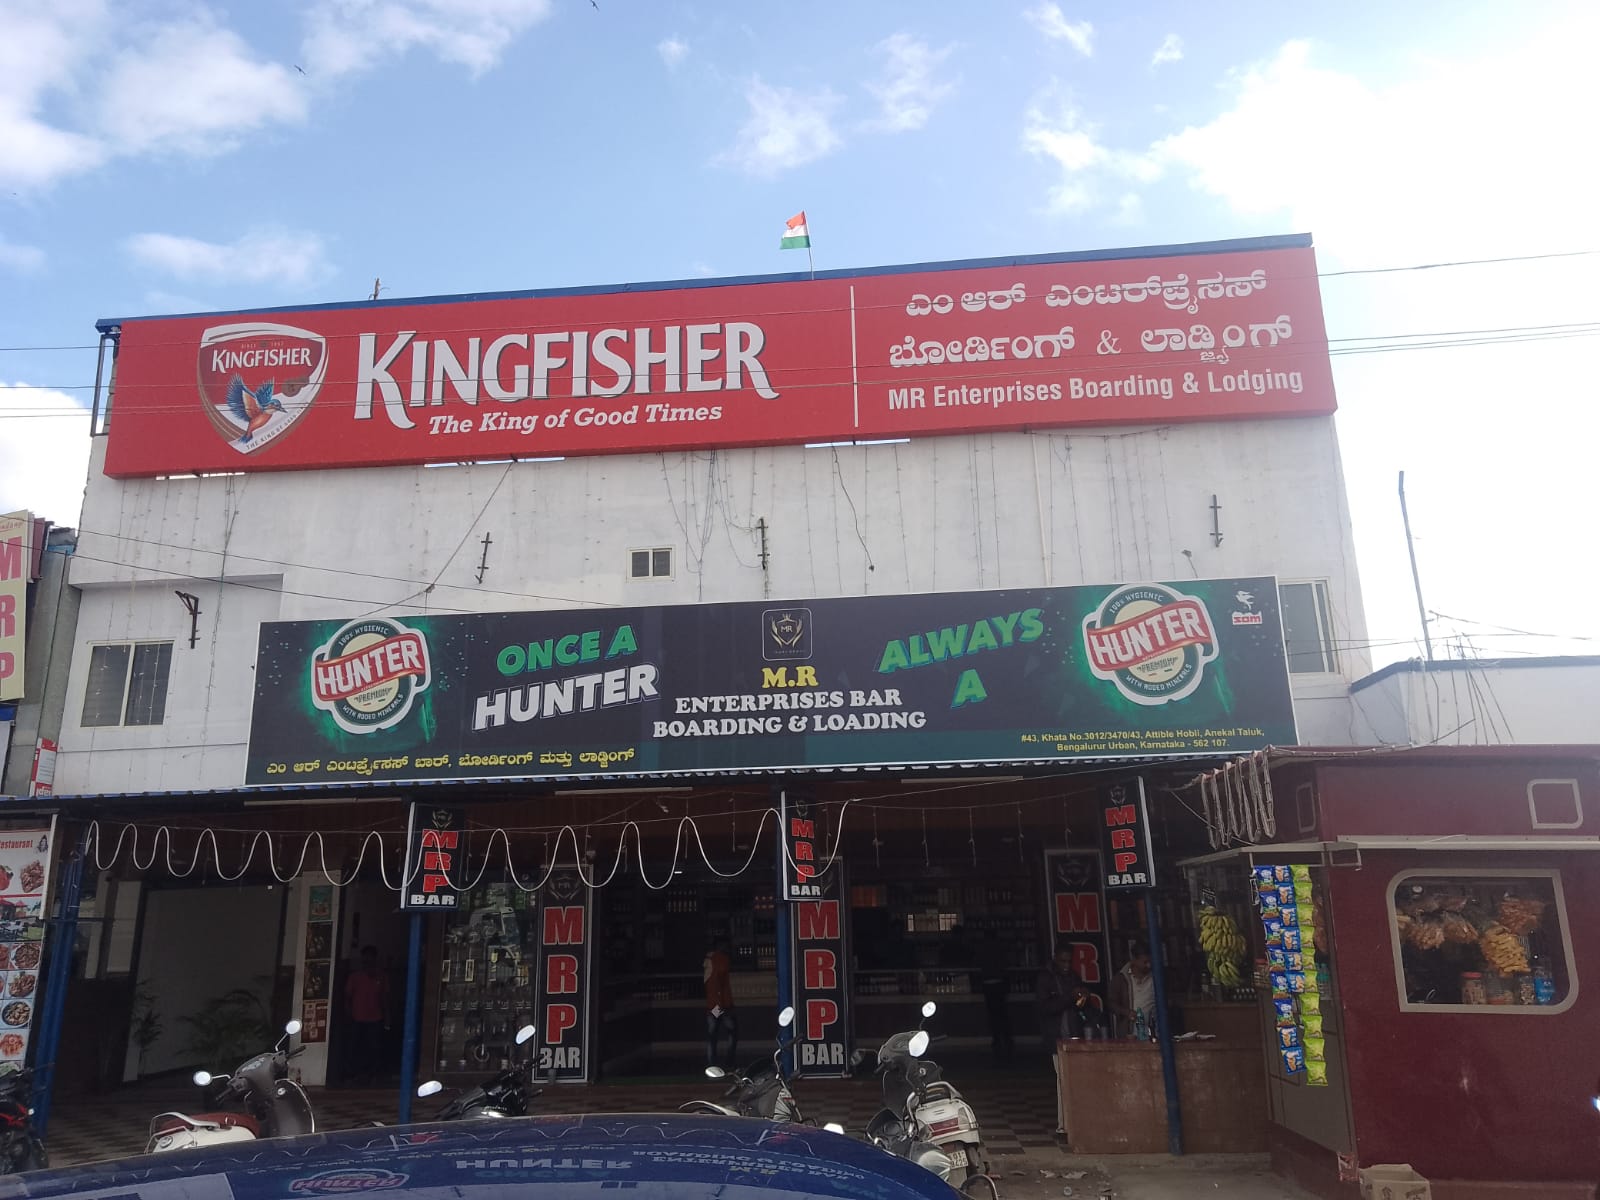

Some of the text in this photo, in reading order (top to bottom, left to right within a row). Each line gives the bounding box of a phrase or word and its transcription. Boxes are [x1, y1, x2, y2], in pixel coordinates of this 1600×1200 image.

[906, 294, 954, 316] ಎಂ
[961, 283, 1026, 312] ಆರ್
[211, 347, 313, 374] KINGFISHER
[889, 326, 1075, 368] ಬೋರ್ಡಿಂಗ್
[1096, 329, 1121, 355] &
[354, 322, 780, 429] KINGFISHER
[888, 368, 1304, 410] MR Enterprises Boarding & Lodging
[429, 403, 723, 436] The King of Good Times
[354, 625, 389, 635] HYGIENIC
[780, 625, 793, 633] MR
[877, 607, 1044, 673] ALWAYS
[1090, 607, 1208, 665] HUNTER
[496, 624, 638, 677] ONCE A
[317, 640, 423, 696] HUNTER
[761, 665, 819, 689] M.R
[473, 663, 660, 731] HUNTER
[675, 688, 902, 714] ENTERPRISES BAR
[951, 669, 988, 708] A
[653, 711, 927, 738] BOARDING & LOADING
[1041, 733, 1067, 742] Khata
[1204, 728, 1235, 737] Anekal
[1108, 741, 1139, 750] Urban,
[1140, 740, 1185, 749] Karnataka
[1193, 739, 1209, 747] 562
[266, 763, 287, 774] ಎಂ
[293, 759, 320, 773] ಆರ್
[539, 750, 573, 767] ಮತ್ತು
[0, 840, 33, 849] estaurant
[791, 818, 815, 883] MRP
[1105, 804, 1137, 872] MRP
[791, 885, 821, 896] BAR
[1108, 872, 1147, 885] BAR
[411, 894, 455, 905] BAR
[543, 906, 584, 1044] MRP
[798, 900, 840, 1041] MRP
[540, 1046, 580, 1069] BAR
[802, 1043, 844, 1066] BAR
